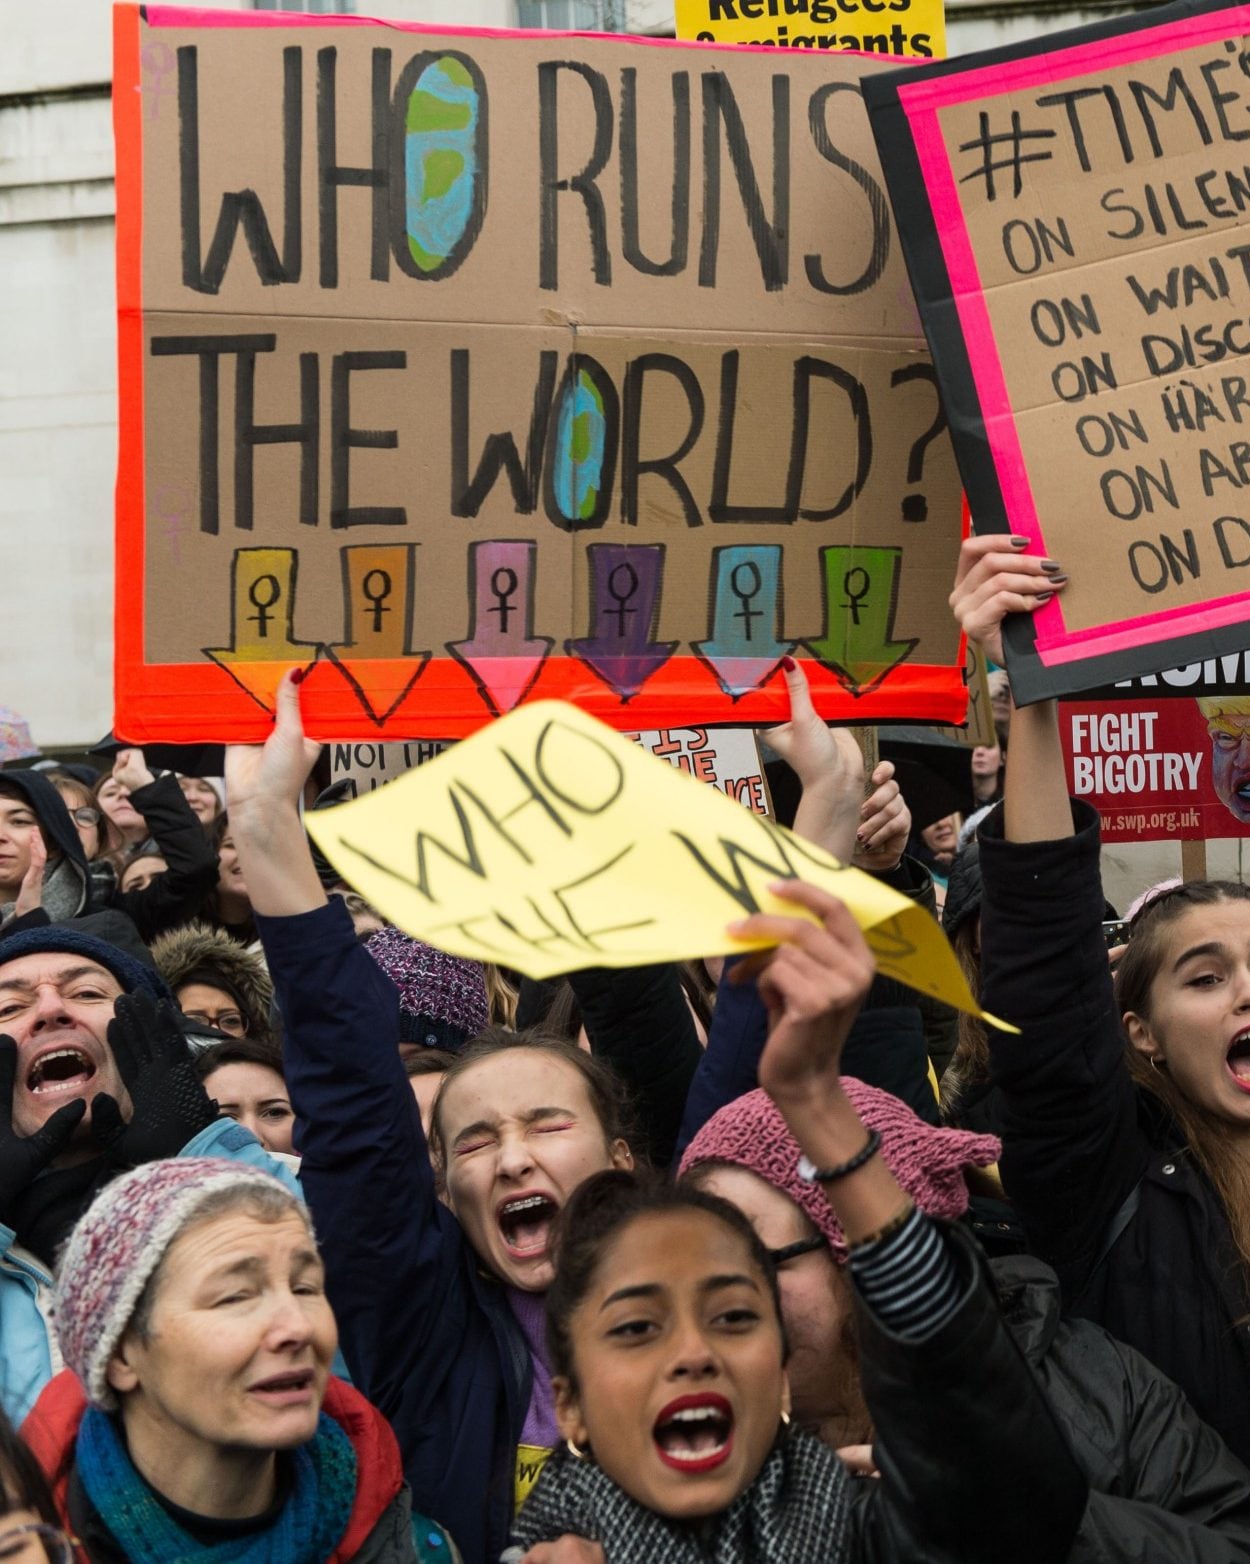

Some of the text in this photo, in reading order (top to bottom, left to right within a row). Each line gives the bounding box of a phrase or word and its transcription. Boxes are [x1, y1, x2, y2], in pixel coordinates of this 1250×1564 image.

[176, 45, 890, 296] WHO RUNS
[1003, 217, 1075, 275] ON
[1029, 293, 1102, 348] ON
[1051, 351, 1119, 404] ON
[150, 332, 408, 537] THE
[1075, 408, 1149, 458] ON
[1099, 458, 1180, 521] ON
[1127, 528, 1201, 595] ON
[1071, 711, 1159, 753] FIGHT
[1073, 751, 1204, 795] BIGOTRY
[338, 717, 624, 904] WHO
[1100, 808, 1200, 834] w.swp.org.uk
[519, 1462, 540, 1483] W
